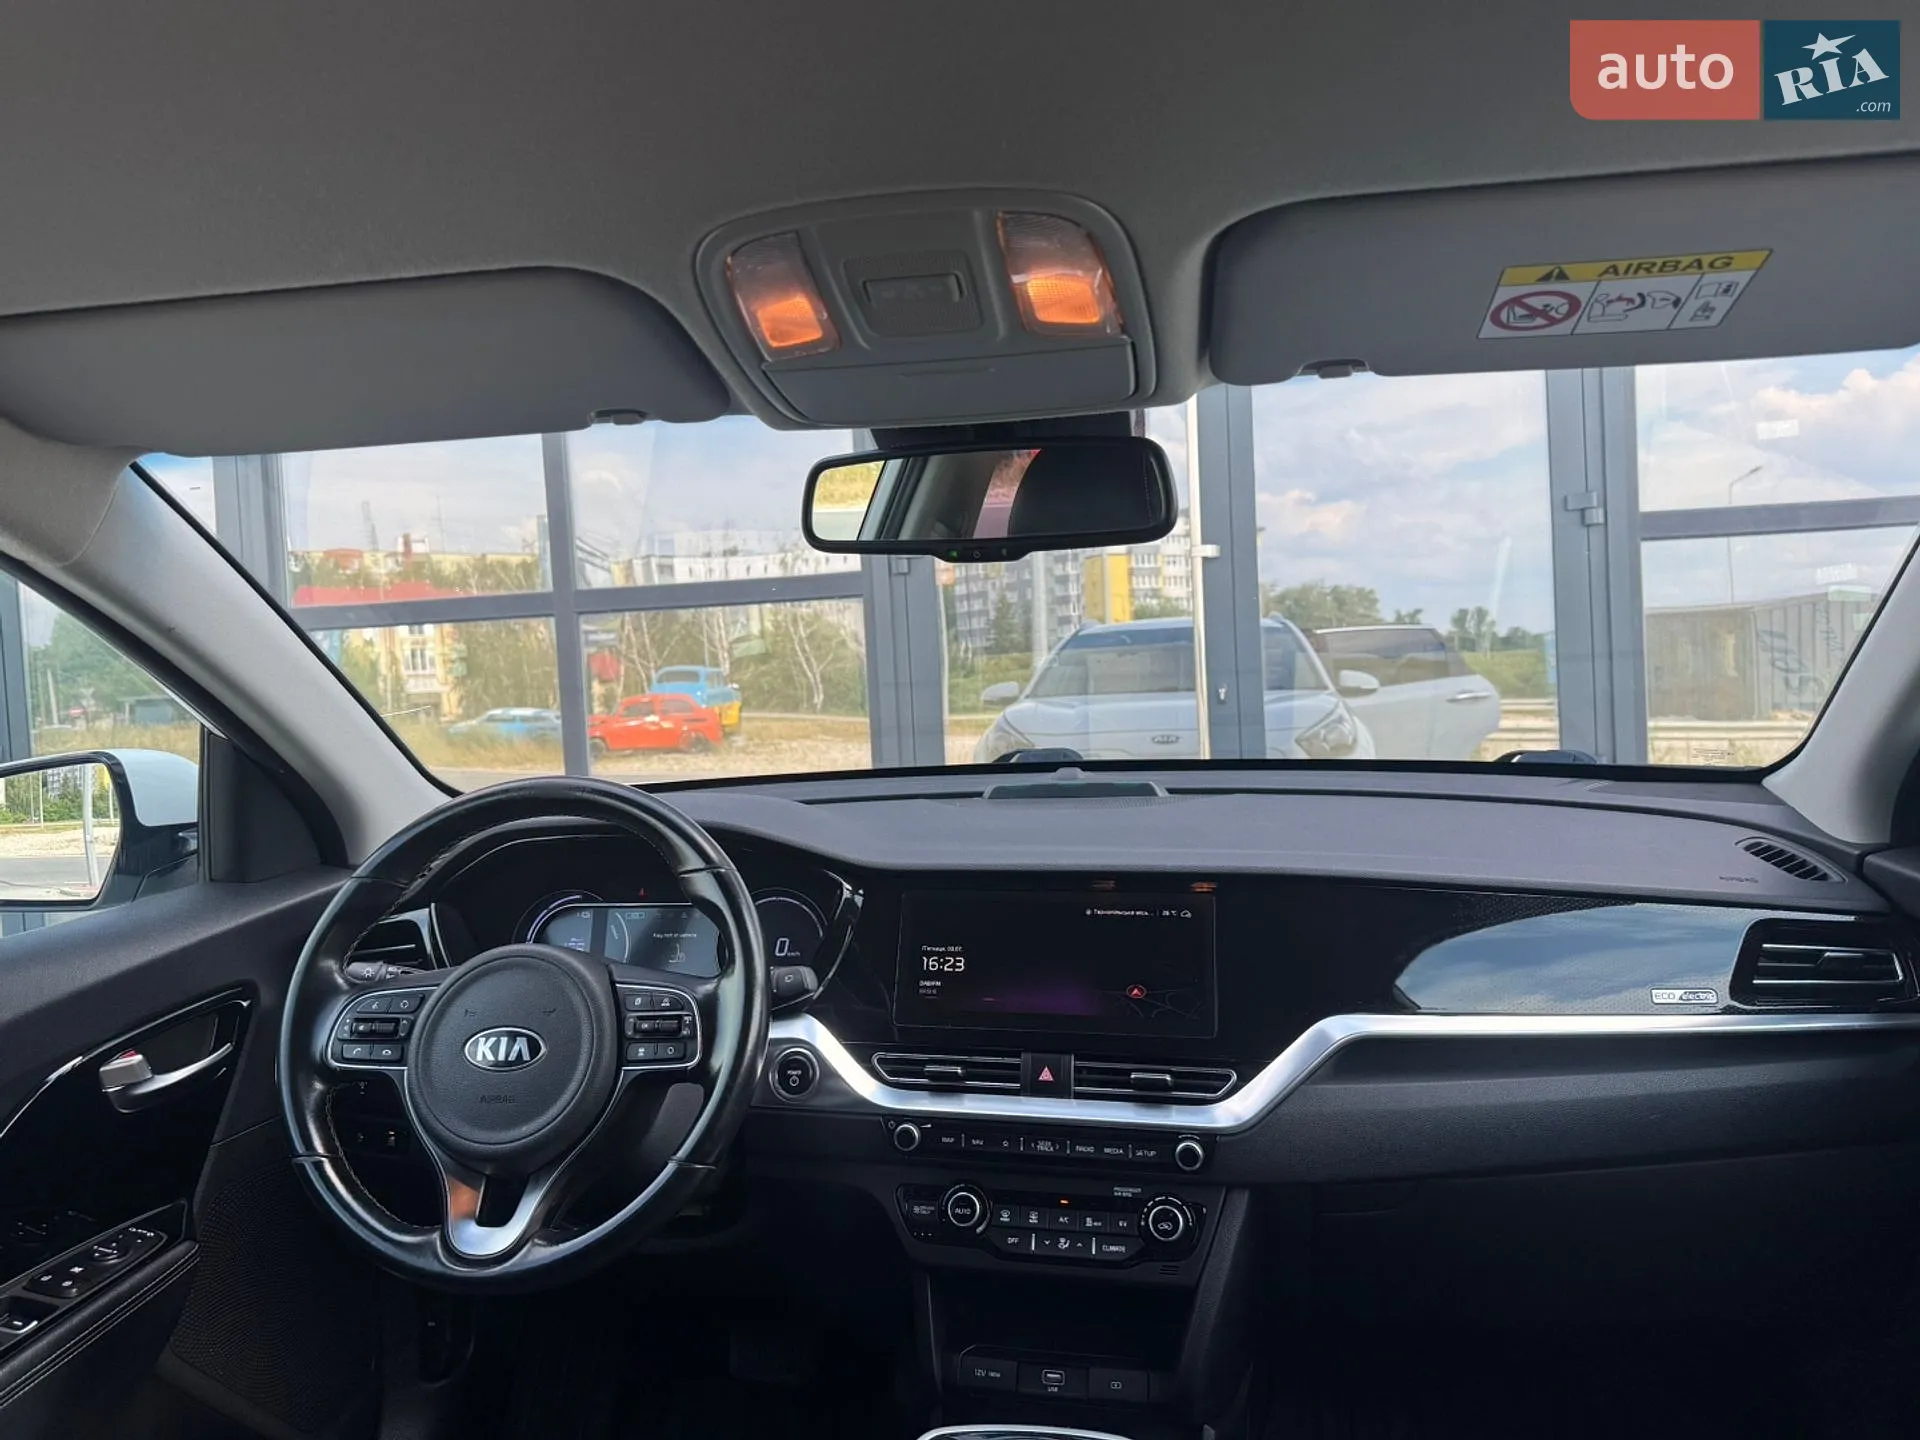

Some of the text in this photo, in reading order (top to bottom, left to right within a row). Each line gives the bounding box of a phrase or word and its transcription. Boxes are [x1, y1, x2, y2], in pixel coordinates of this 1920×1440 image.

[1597, 256, 1735, 278] AIRBAG
[775, 937, 790, 956] 0
[922, 956, 965, 972] 16:23
[1655, 992, 1676, 1000] ECO
[475, 1036, 531, 1061] KIA
[1075, 1145, 1096, 1153] RADIO
[1103, 1147, 1125, 1155] MEDIA
[1135, 1149, 1158, 1158] SETUP
[954, 1207, 971, 1215] AUTO
[1101, 1244, 1127, 1253] CLIMATE
